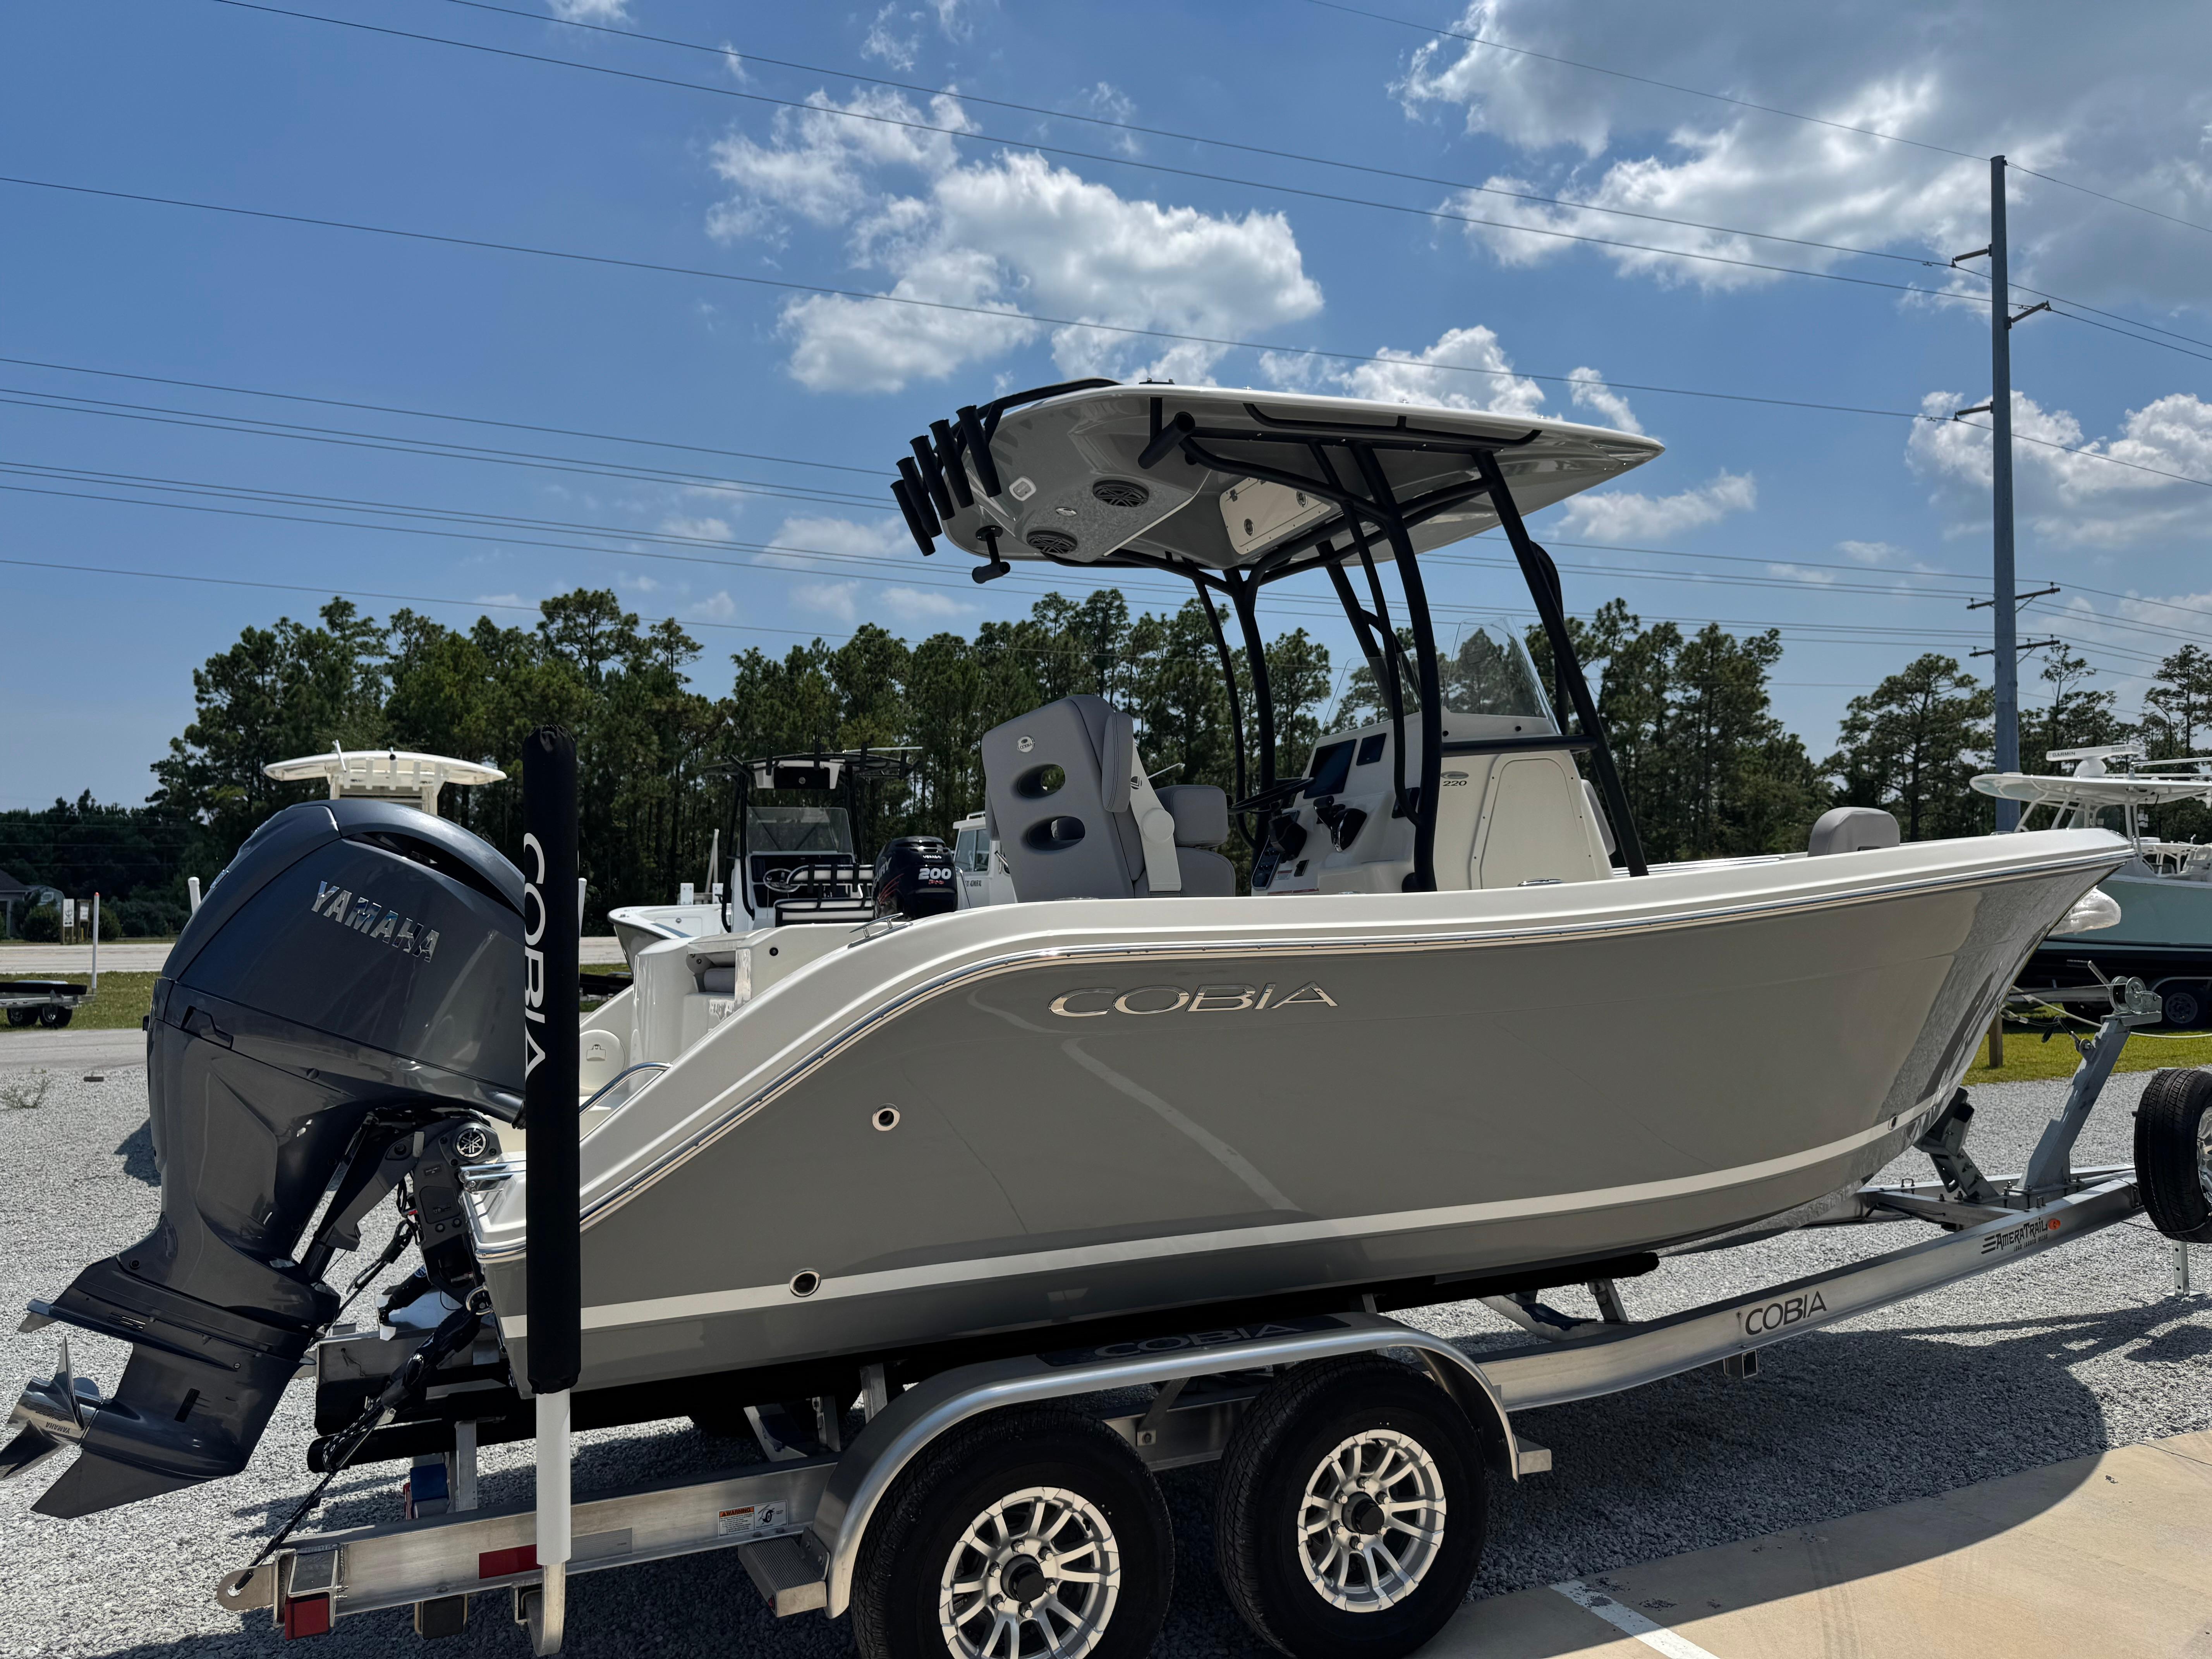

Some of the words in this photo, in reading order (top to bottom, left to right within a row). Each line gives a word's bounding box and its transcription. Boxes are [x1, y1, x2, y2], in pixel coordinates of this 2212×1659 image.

[918, 868, 951, 880] 200
[311, 881, 440, 963] YAMAHA
[524, 833, 546, 1082] COBIA
[1048, 981, 1338, 1017] COBIA
[1745, 1291, 1827, 1335] COBIA
[1094, 1324, 1304, 1356] COBIA
[46, 1422, 70, 1434] YAMAHA
[726, 1508, 751, 1516] WARNING
